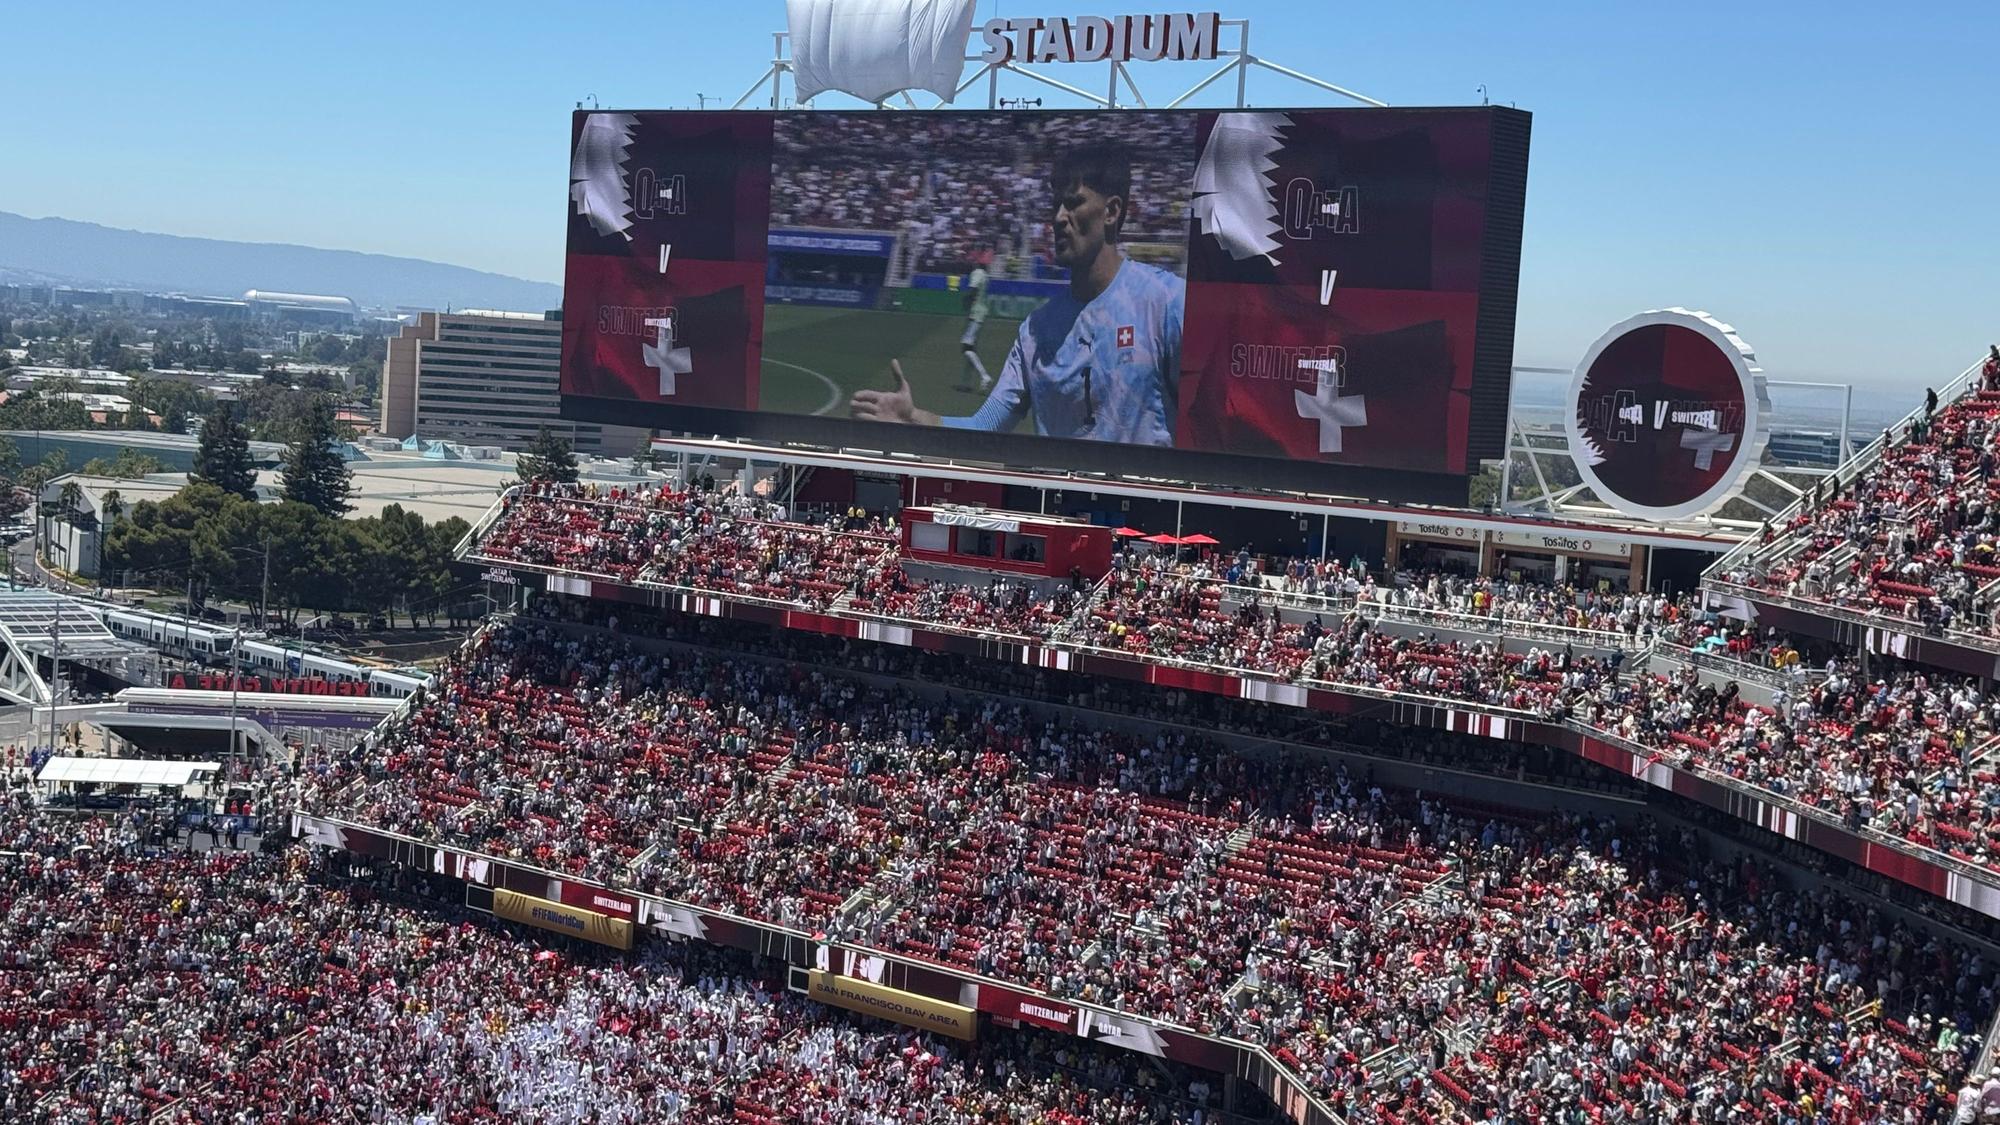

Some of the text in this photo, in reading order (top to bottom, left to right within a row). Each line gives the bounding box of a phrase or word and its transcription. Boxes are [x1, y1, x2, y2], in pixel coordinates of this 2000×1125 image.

[982, 12, 1219, 64] STADIUM
[660, 244, 672, 274] V
[1320, 270, 1338, 306] V
[1653, 400, 1670, 430] V
[1418, 523, 1449, 537] Tostitos
[1542, 536, 1579, 551] Tostitos
[480, 572, 516, 585] SWITZERLAND
[489, 567, 508, 577] QATAR
[531, 906, 585, 933] #FIFAWorldCup
[593, 895, 632, 914] SWITZERLAND
[637, 900, 650, 925] V
[816, 983, 960, 1027] SAN FRANCISCO BAY AREA
[1019, 1002, 1069, 1024] SWITZERLAND
[1077, 1007, 1093, 1038] V
[1098, 1021, 1122, 1037] QATAR
